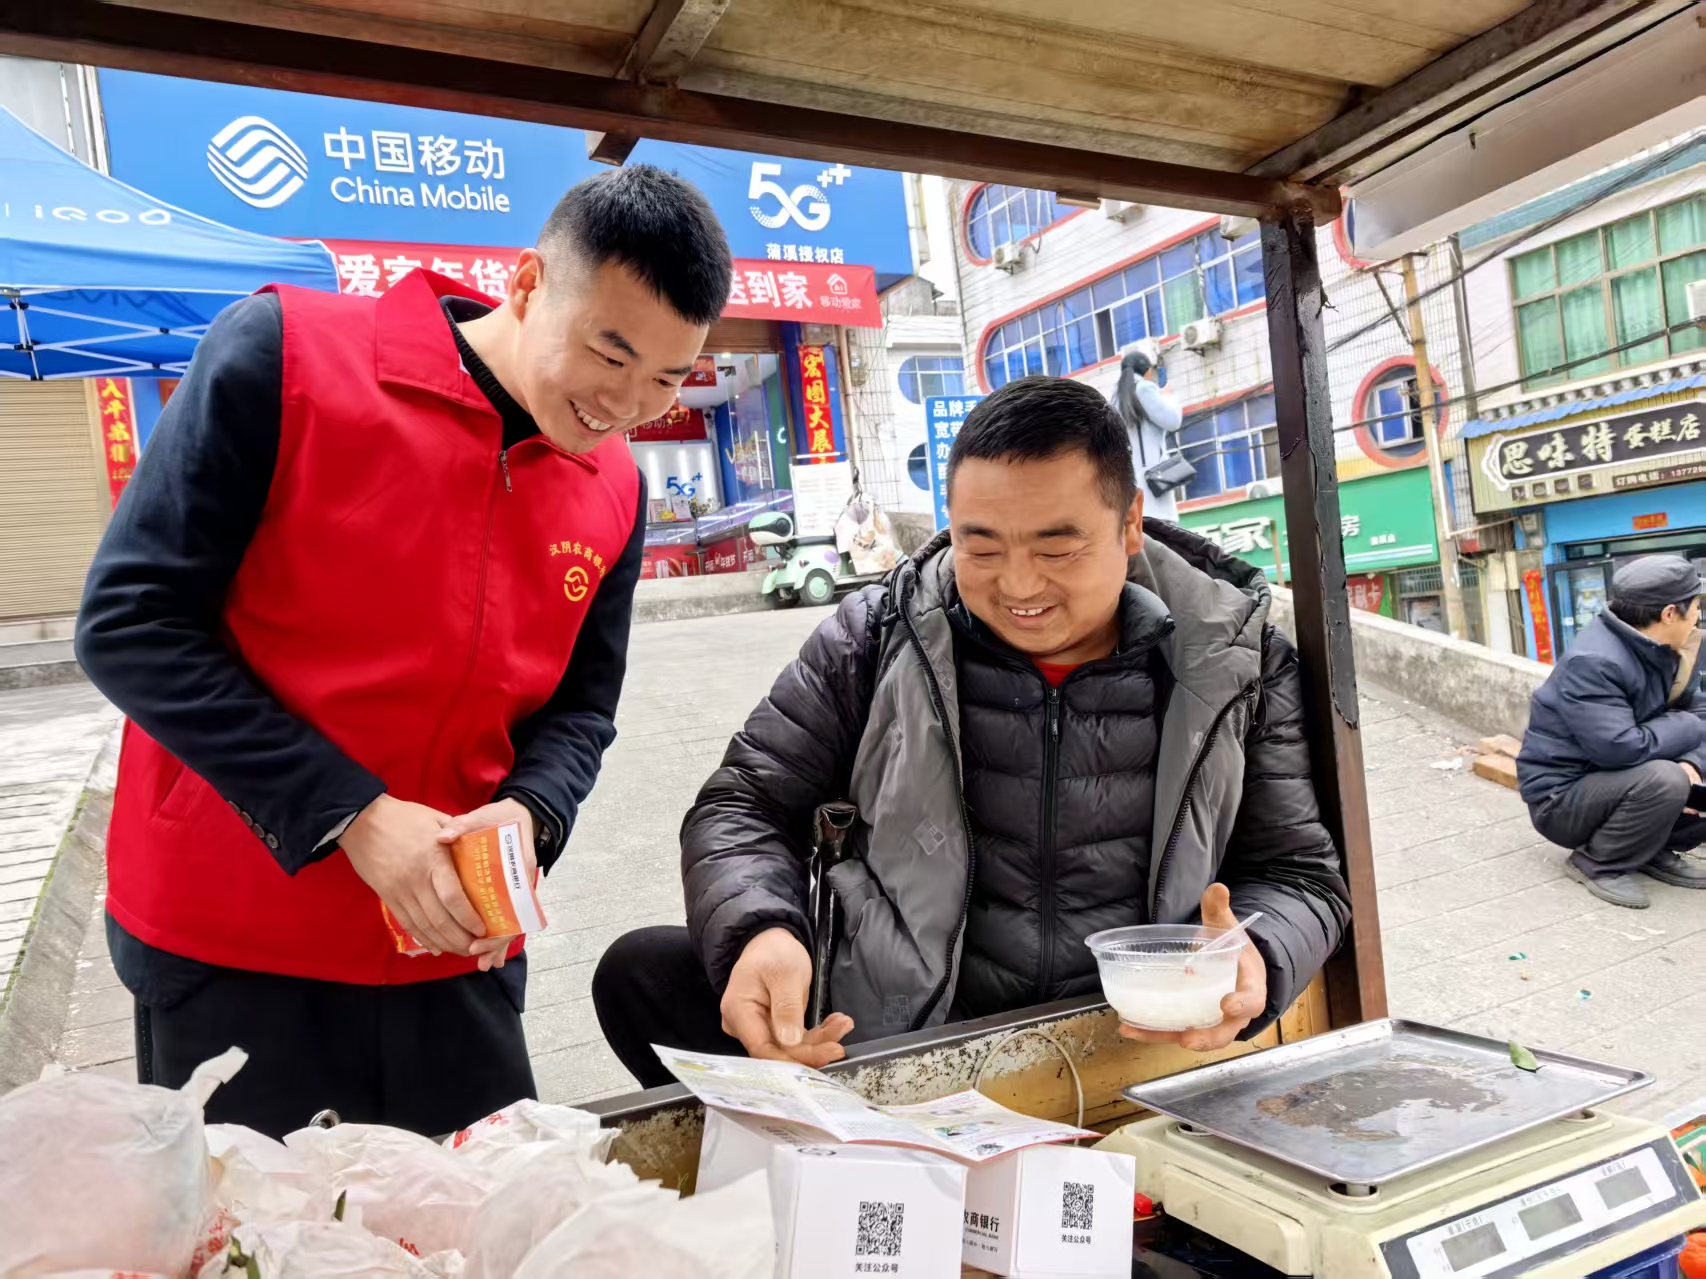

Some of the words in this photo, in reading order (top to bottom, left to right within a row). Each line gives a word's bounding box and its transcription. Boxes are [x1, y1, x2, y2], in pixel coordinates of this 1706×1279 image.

[324, 126, 505, 180] 中国移动
[331, 176, 415, 207] China
[420, 183, 510, 213] Mobile
[338, 253, 516, 299] 爱家年货
[1502, 421, 1617, 475] 思味特
[1623, 413, 1702, 449] 蛋糕店
[1061, 1234, 1092, 1245] 关注公众号
[855, 1262, 898, 1273] 关注公众号
